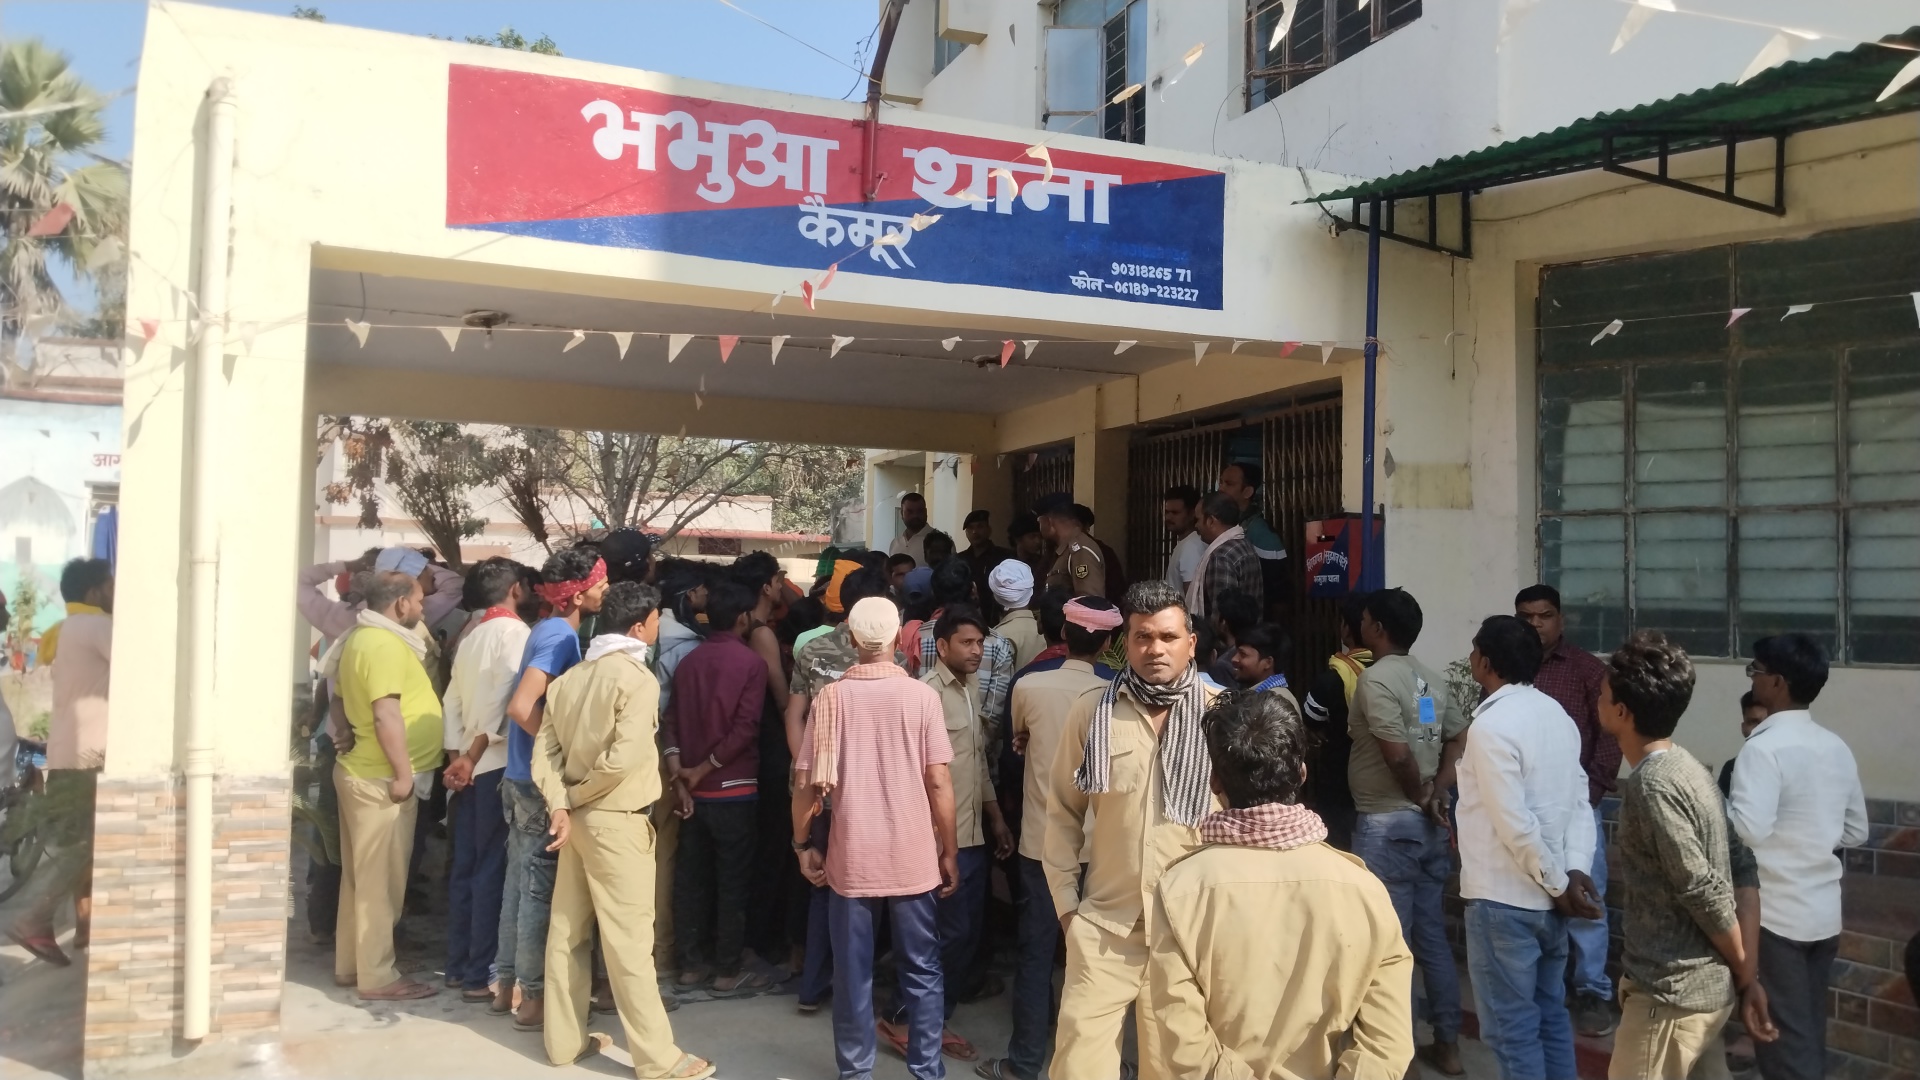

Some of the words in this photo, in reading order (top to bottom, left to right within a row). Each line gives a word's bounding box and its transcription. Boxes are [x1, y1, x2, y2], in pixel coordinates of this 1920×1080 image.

[580, 99, 839, 203] भभुआ
[903, 146, 1122, 224] थाना
[798, 194, 916, 269] कैमूर
[1111, 262, 1172, 281] 90318265
[1176, 268, 1192, 282] 71
